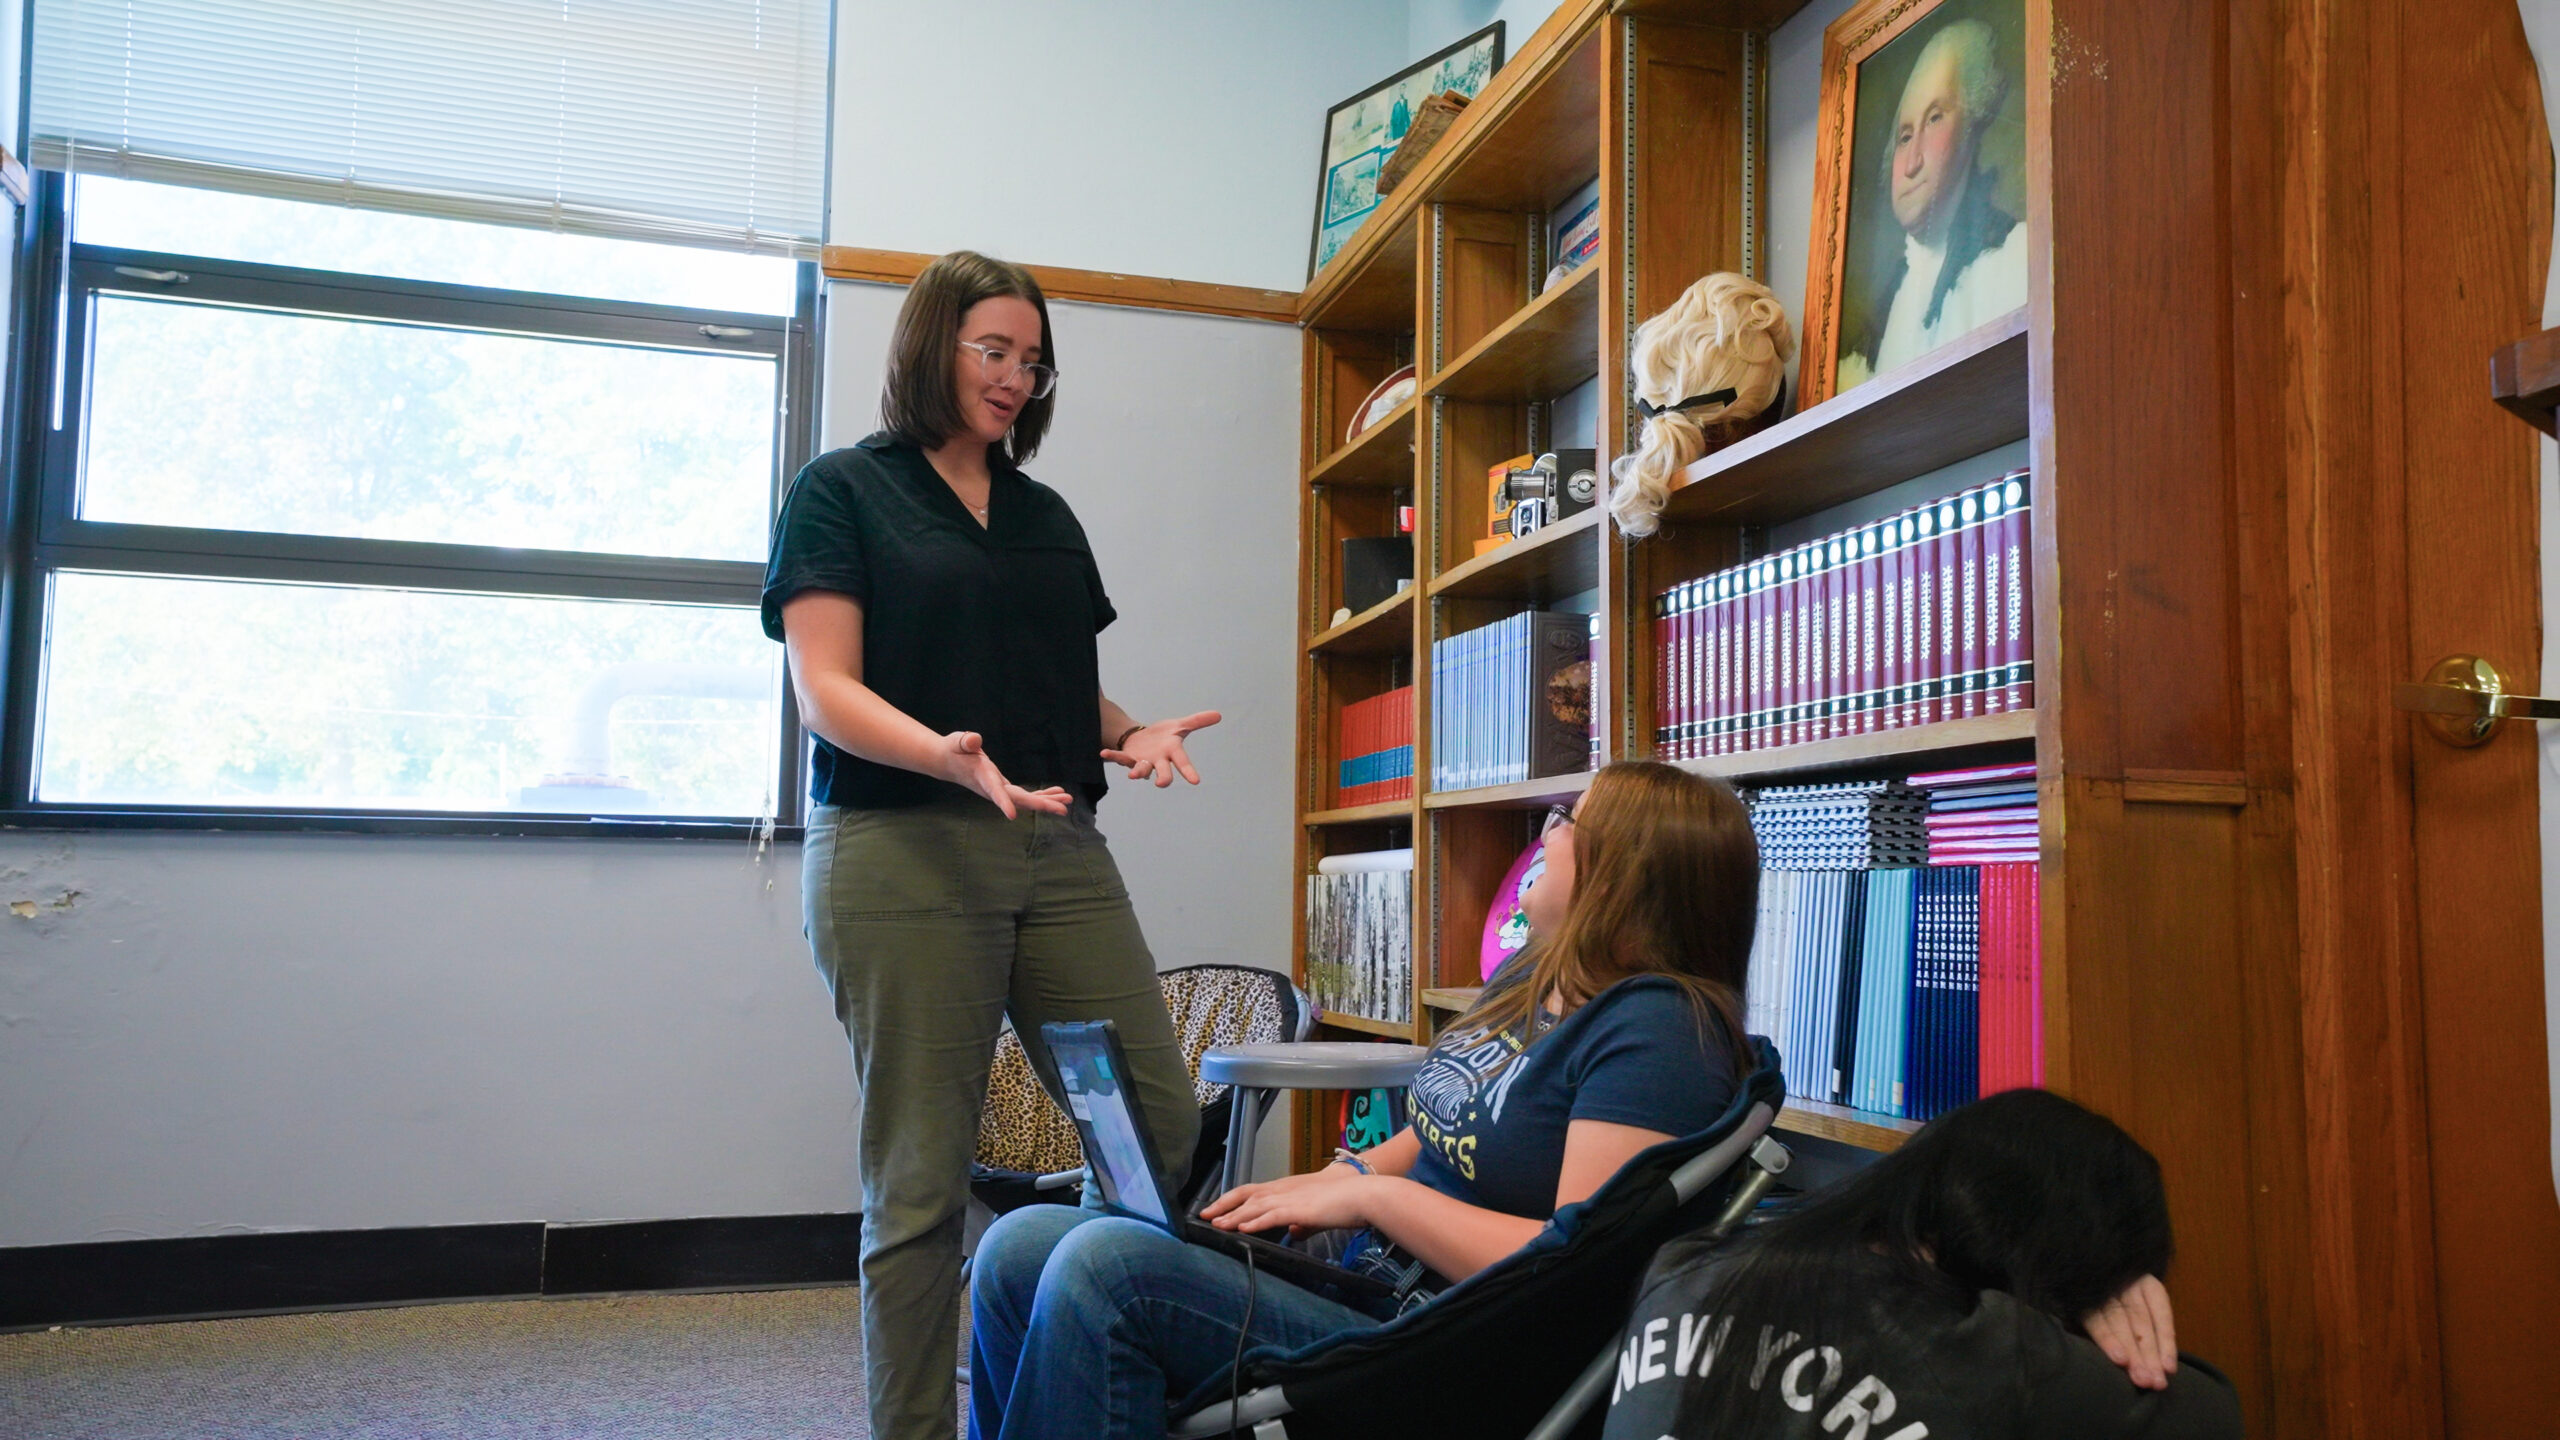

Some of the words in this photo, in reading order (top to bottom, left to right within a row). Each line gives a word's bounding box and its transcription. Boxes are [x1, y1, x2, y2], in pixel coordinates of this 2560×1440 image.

[1923, 895, 1931, 988] CLAYTONIAN
[1932, 895, 1940, 988] CLAYTONIAN
[1612, 1313, 1735, 1405] NEW
